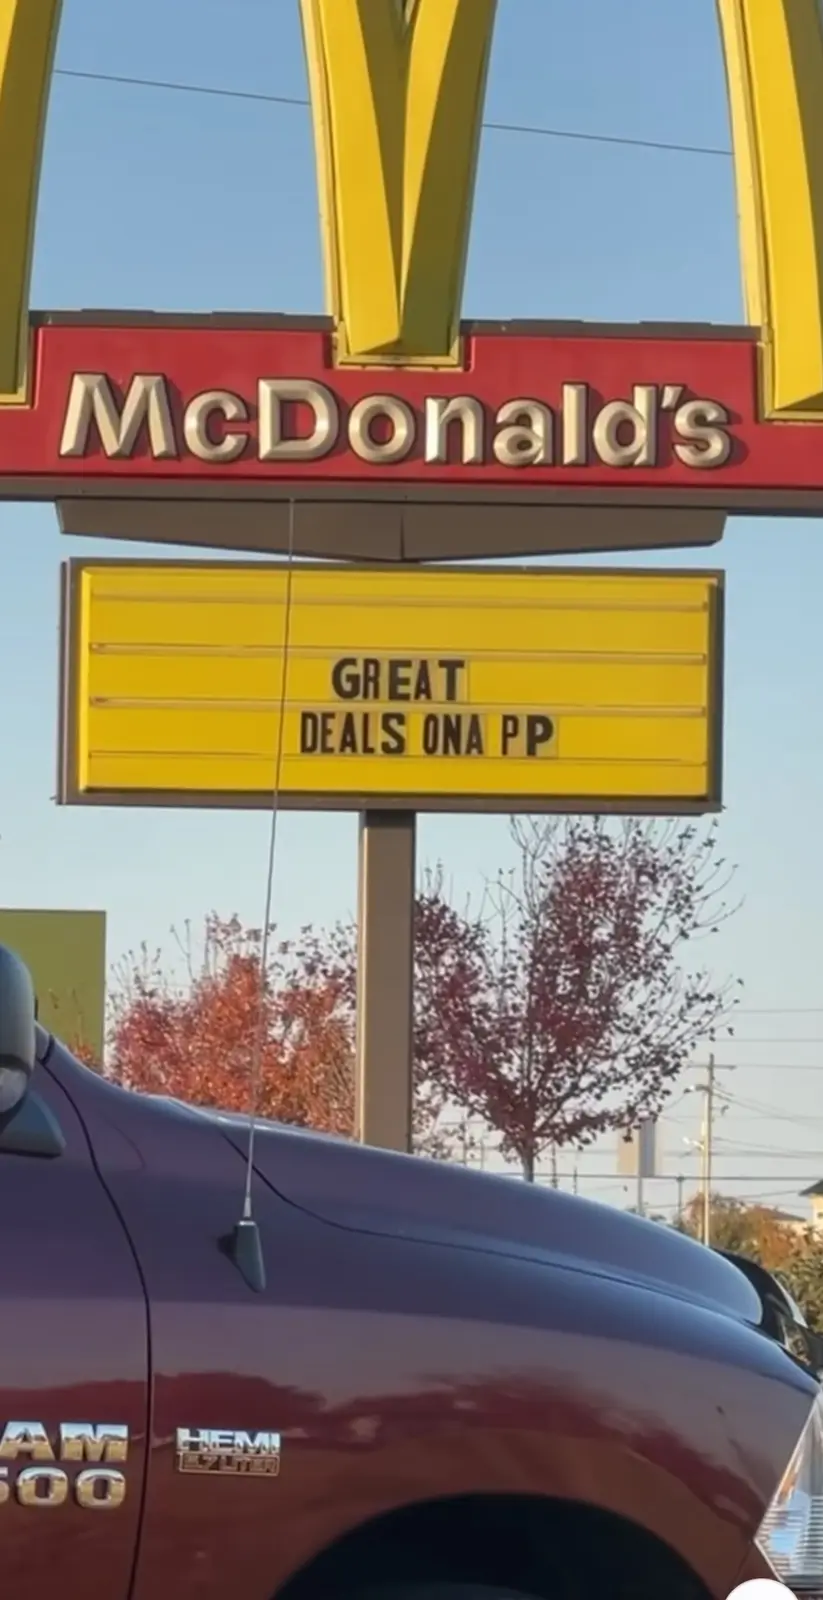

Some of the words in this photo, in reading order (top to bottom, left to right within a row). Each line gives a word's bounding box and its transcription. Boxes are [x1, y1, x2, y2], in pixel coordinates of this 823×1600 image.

[58, 372, 733, 469] McDonald's
[332, 657, 465, 701] GREAT
[301, 711, 406, 755] DEALS
[176, 1427, 281, 1454] HEMI
[0, 1466, 126, 1508] 00
